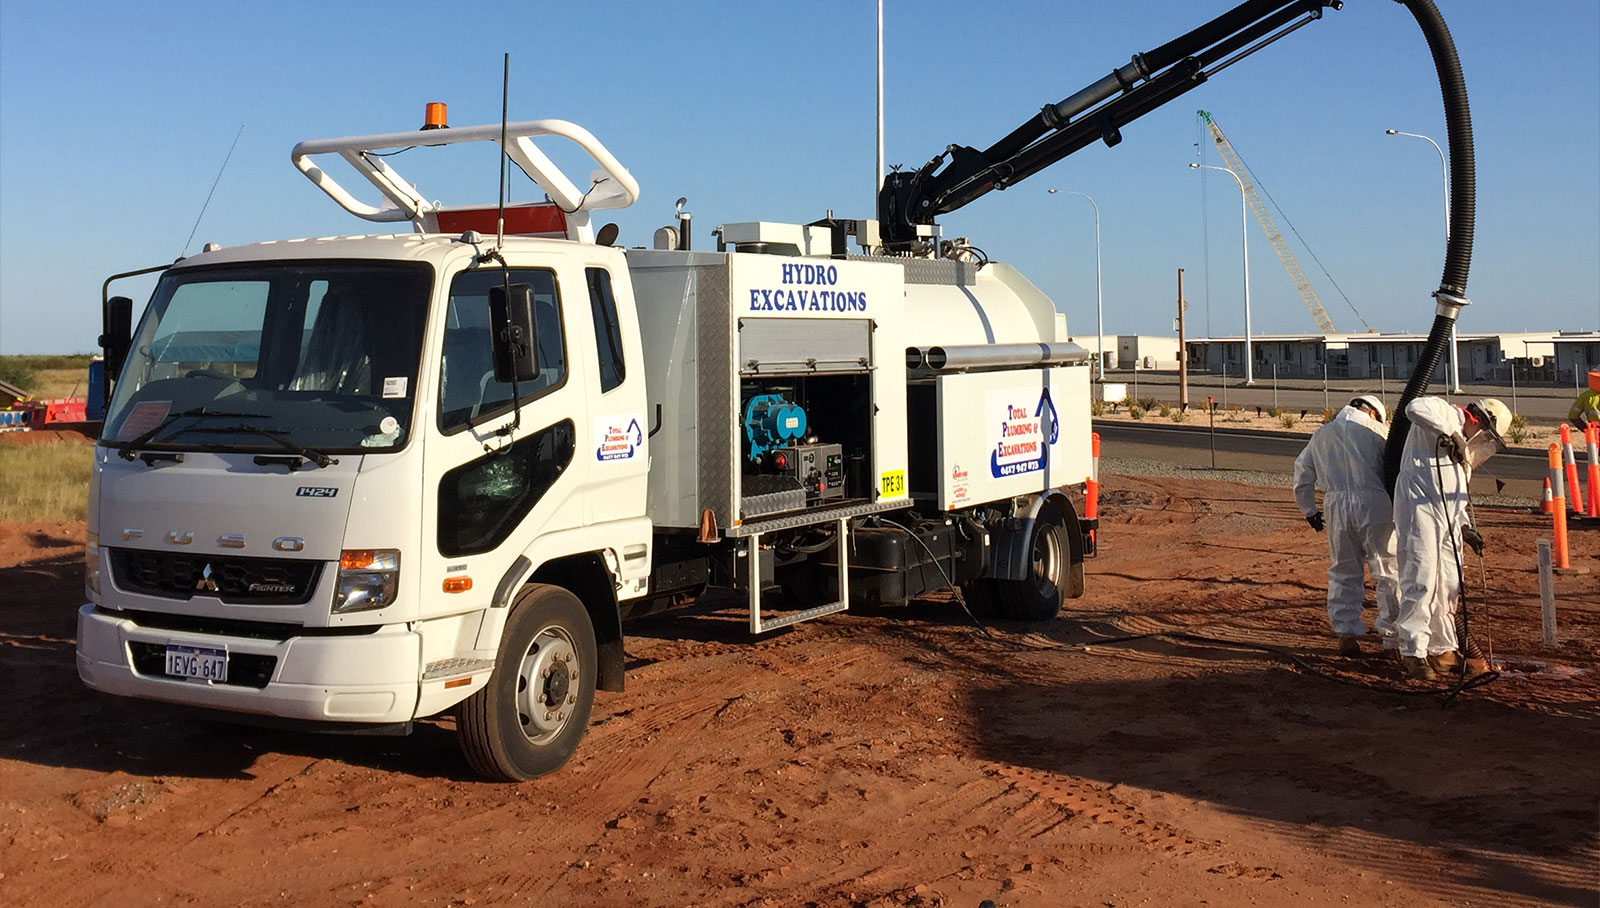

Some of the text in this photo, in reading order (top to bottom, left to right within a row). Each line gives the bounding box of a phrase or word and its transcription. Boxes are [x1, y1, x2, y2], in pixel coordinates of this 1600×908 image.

[782, 263, 838, 285] HYDRO
[750, 289, 867, 312] EXCAVATIONS
[1008, 404, 1027, 420] TOTAL
[299, 487, 336, 497] 1424
[882, 475, 904, 493] TPE 31
[123, 528, 304, 551] FUSO
[169, 654, 224, 679] 1EVG 647
